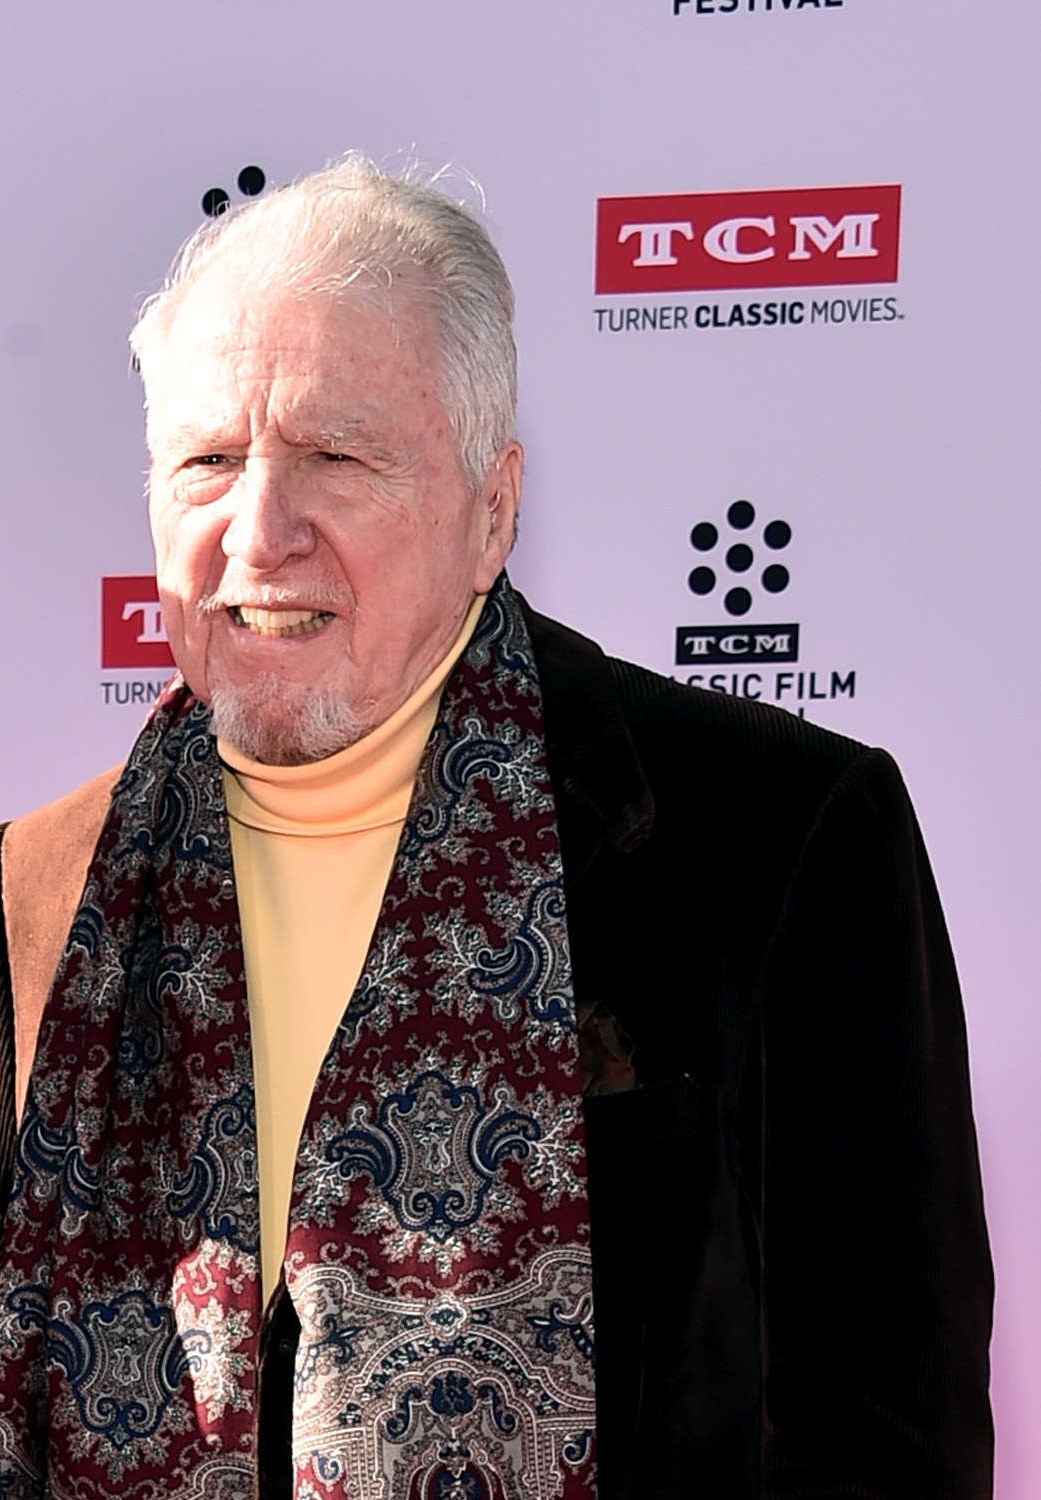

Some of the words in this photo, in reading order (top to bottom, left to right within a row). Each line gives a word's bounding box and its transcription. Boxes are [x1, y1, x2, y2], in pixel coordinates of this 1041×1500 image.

[618, 213, 880, 268] TCM
[594, 306, 688, 333] TURNER
[694, 301, 804, 328] CLASSIC
[683, 633, 792, 656] TCM
[100, 681, 168, 705] TURN
[775, 671, 856, 700] FILM
